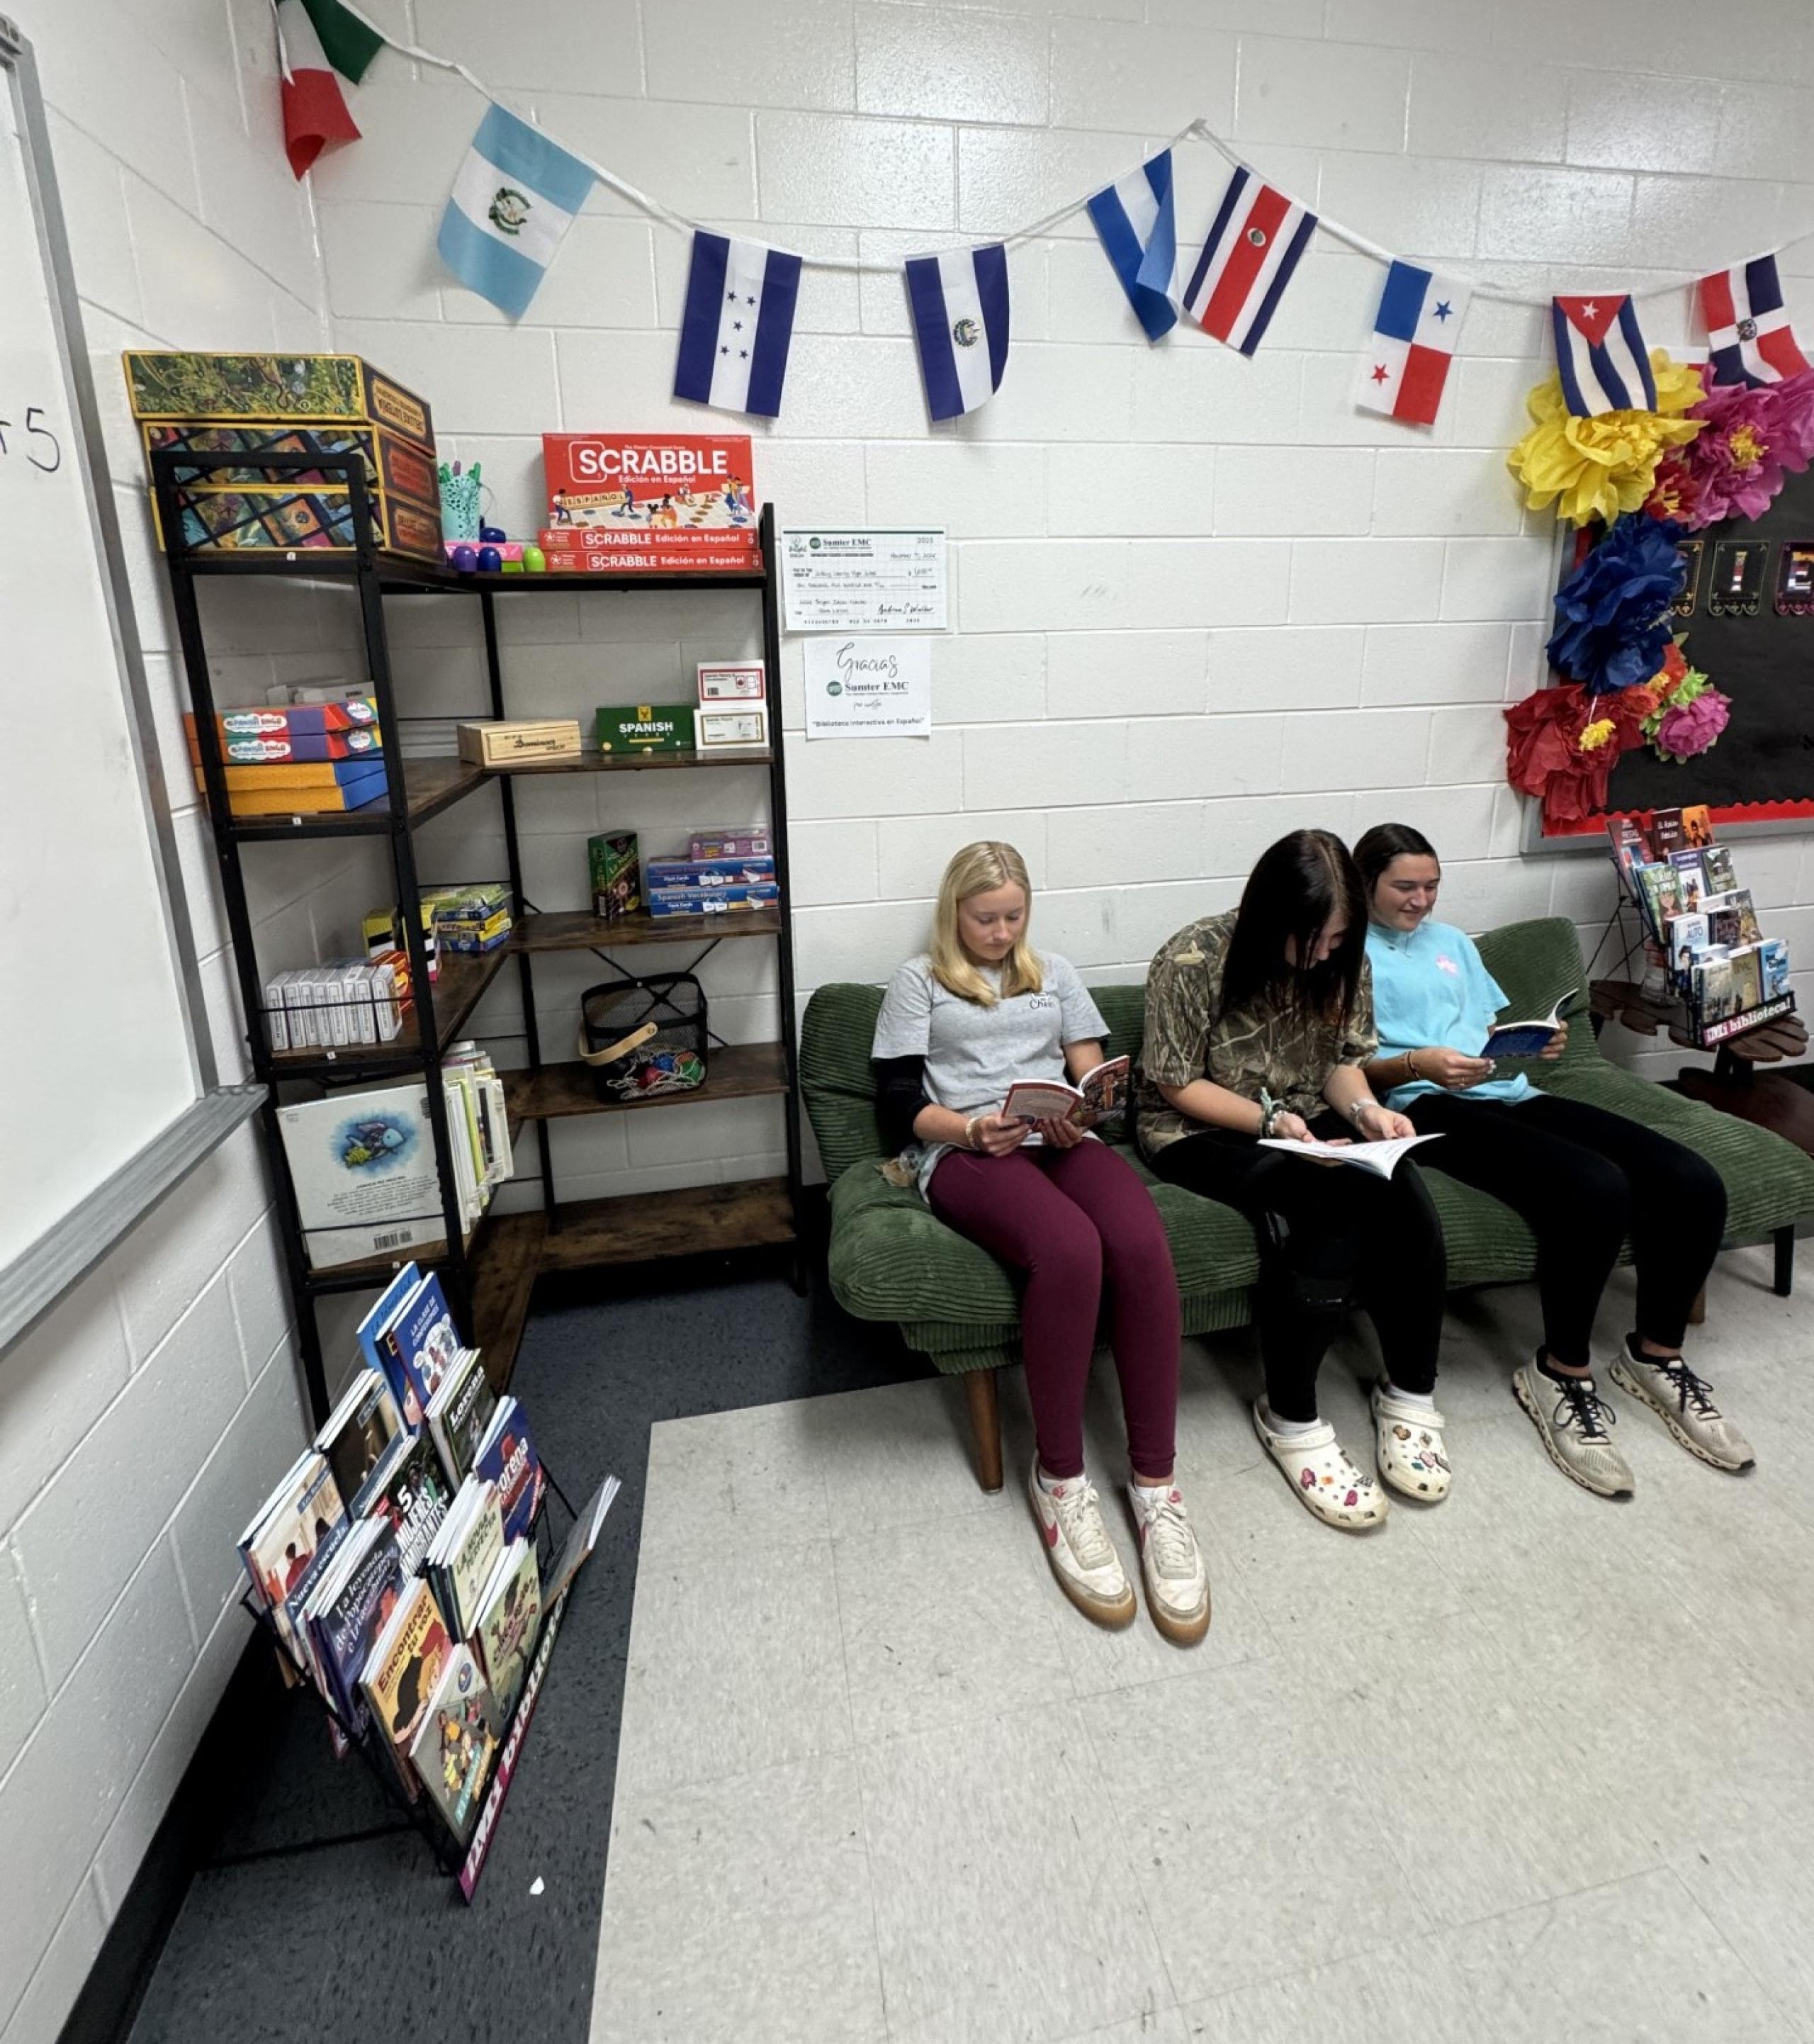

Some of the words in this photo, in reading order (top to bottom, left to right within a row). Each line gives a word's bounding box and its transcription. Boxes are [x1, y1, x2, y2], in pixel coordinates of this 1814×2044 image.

[578, 449, 728, 475] SCRABBLE
[618, 474, 650, 484] Edición
[663, 475, 696, 485] Español
[585, 533, 652, 545] SCRABBLE
[655, 533, 689, 543] Edición
[704, 533, 740, 544] Español
[591, 556, 658, 568] SCRABBLE
[660, 556, 694, 566] Edición
[709, 556, 745, 566] Español
[836, 641, 898, 683] Gracias
[845, 682, 881, 692] Sumter
[883, 681, 909, 691] EMC
[619, 721, 674, 734] SPANISH
[1731, 996, 1791, 1032] biblioteca!
[450, 1365, 485, 1423] Lorena
[497, 1437, 529, 1488] orena
[397, 1484, 412, 1513] 5
[288, 1568, 318, 1607] Nueva
[377, 1594, 429, 1694] Encontrar
